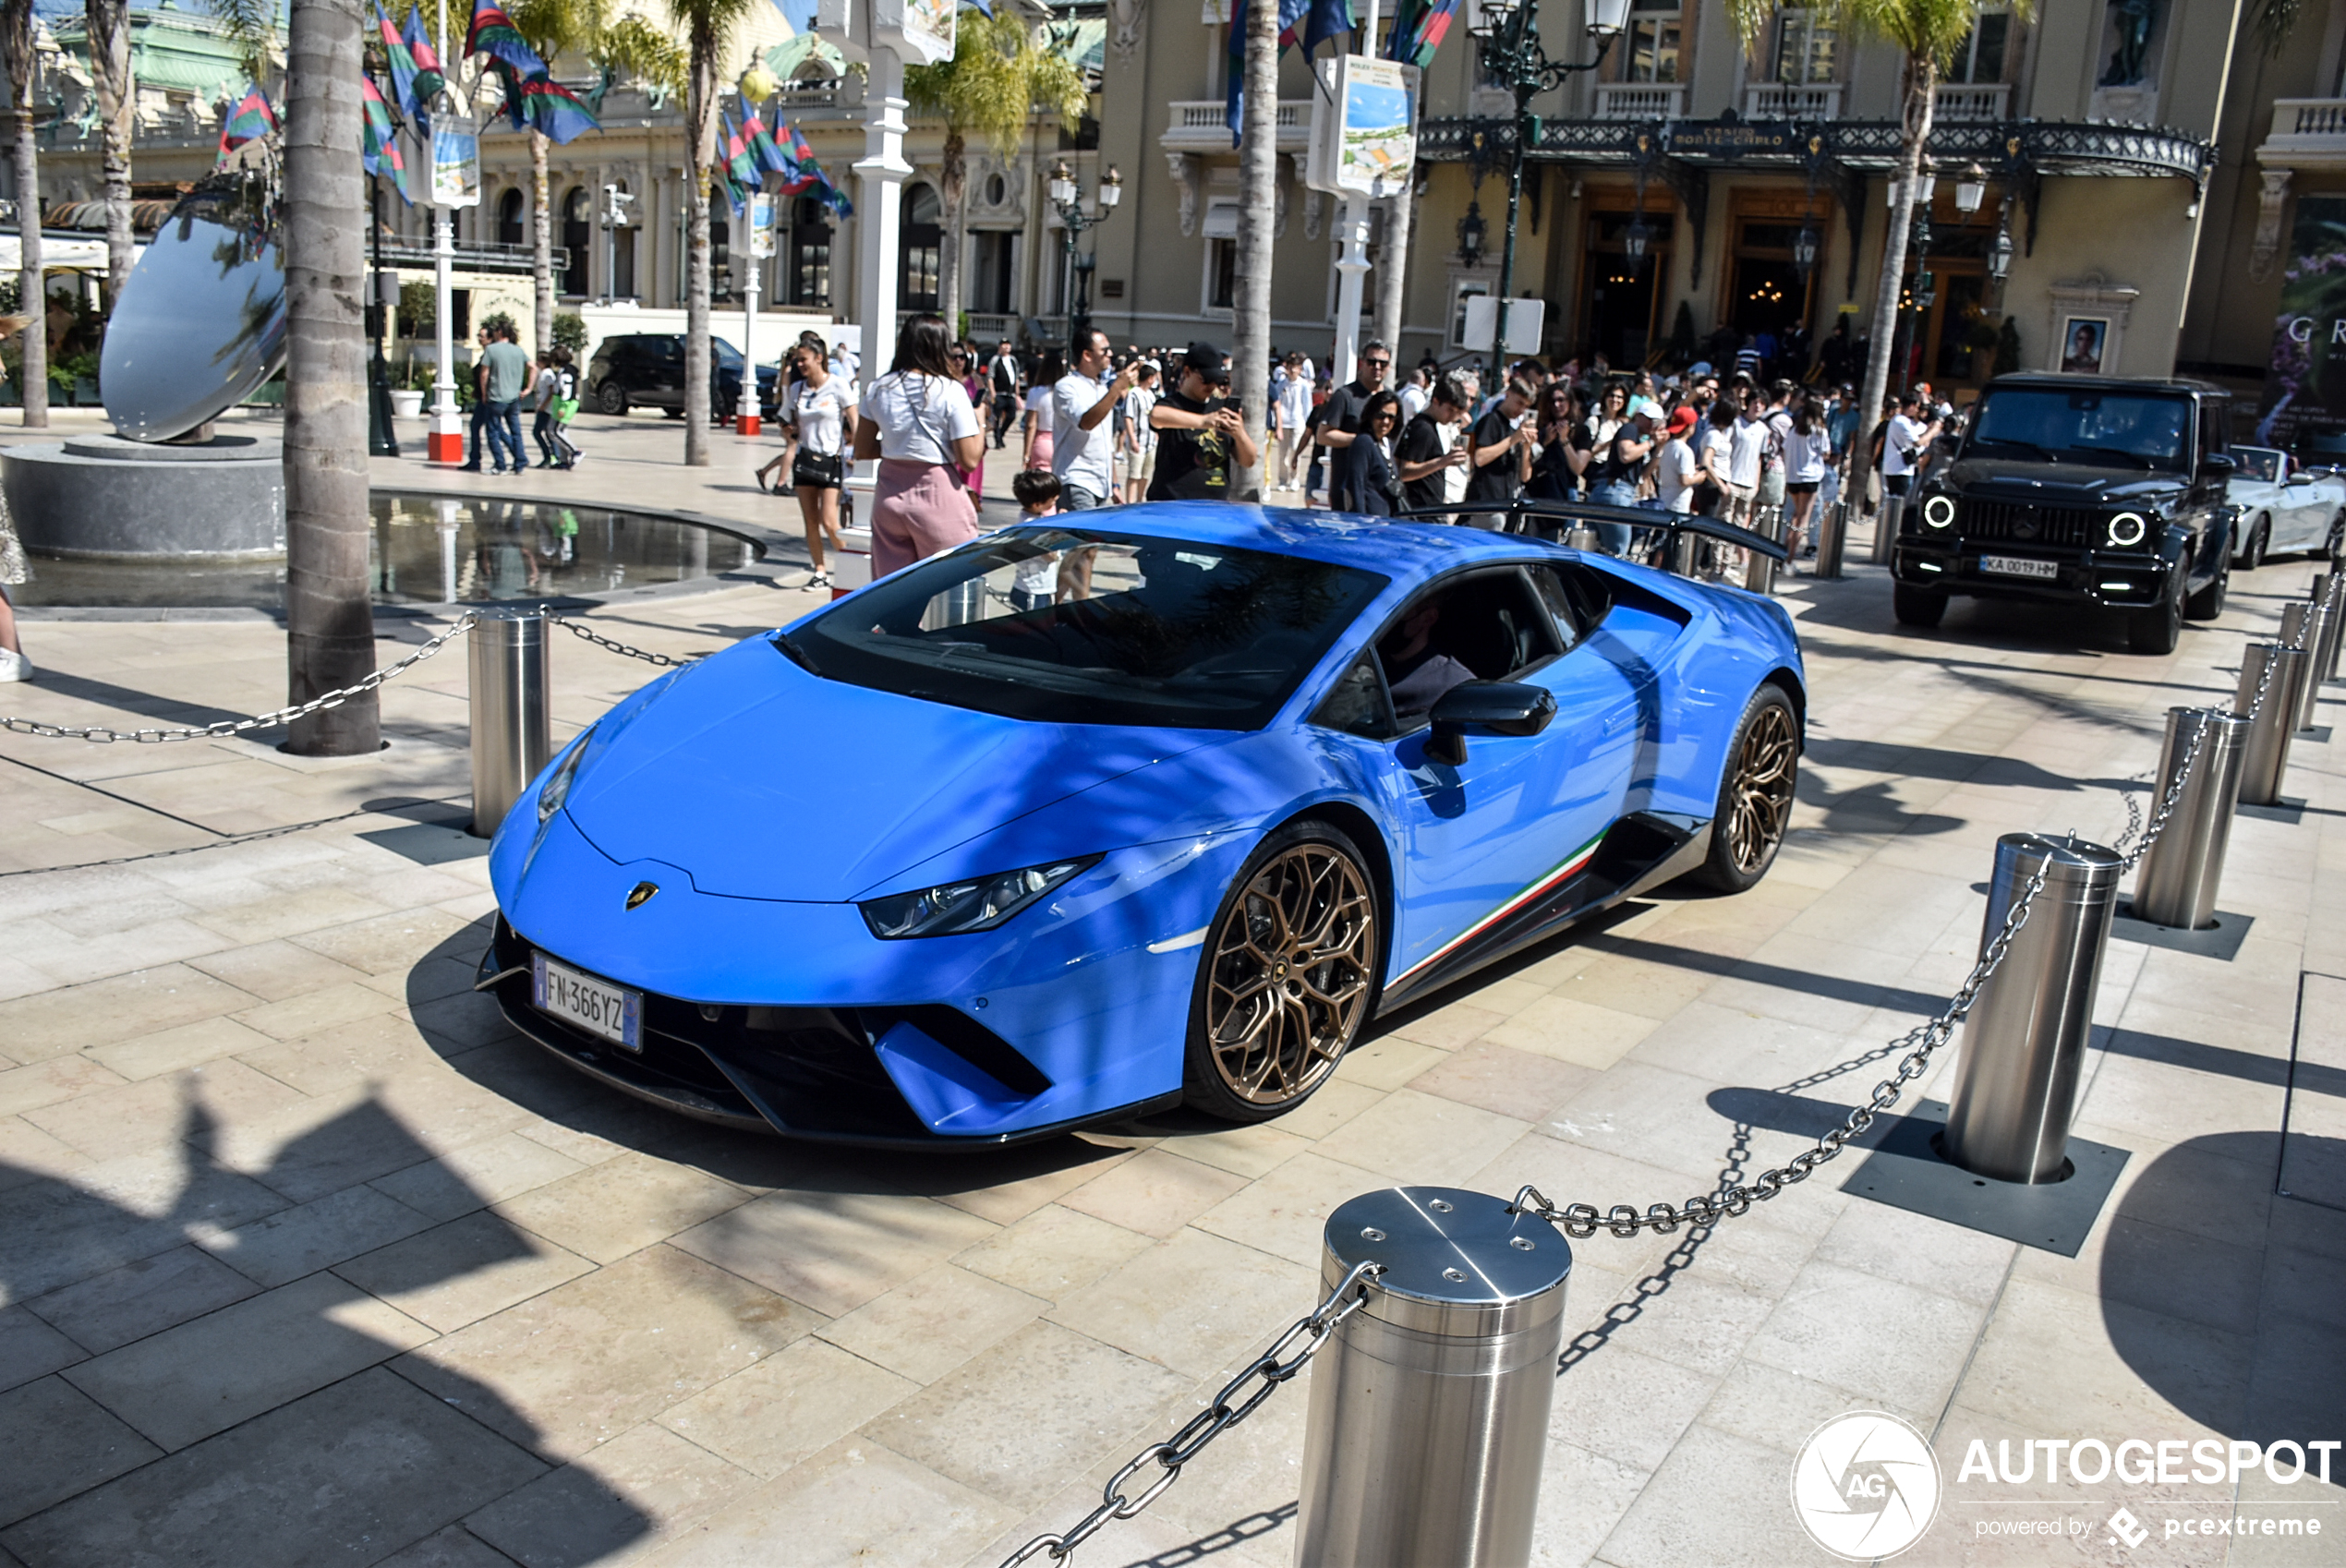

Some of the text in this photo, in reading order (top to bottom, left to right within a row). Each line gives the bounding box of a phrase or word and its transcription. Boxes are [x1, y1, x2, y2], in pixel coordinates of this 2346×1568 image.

[1704, 127, 1755, 137] CASINO
[1987, 557, 2056, 575] KA 0019 HM
